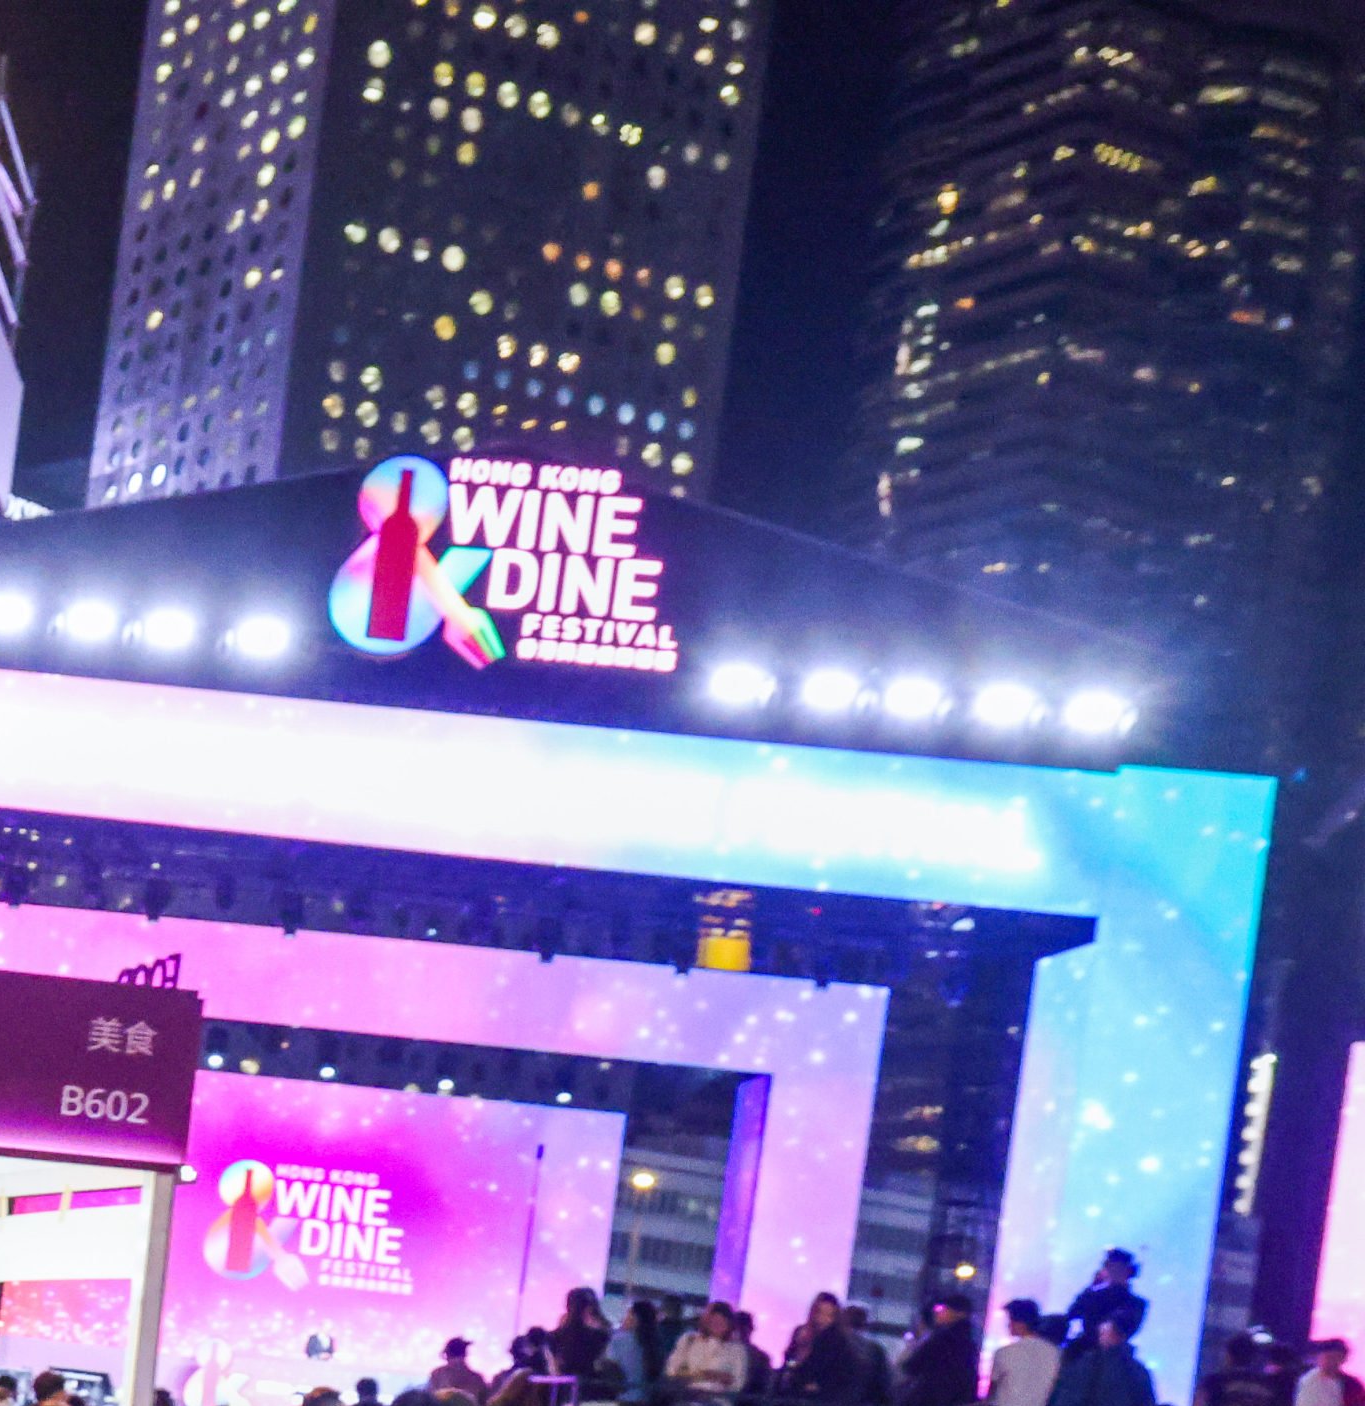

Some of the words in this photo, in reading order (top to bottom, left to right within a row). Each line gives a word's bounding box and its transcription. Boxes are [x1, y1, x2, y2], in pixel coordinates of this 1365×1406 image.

[449, 457, 532, 488] HONG
[537, 464, 623, 496] KONG
[448, 483, 644, 559] WINE
[485, 547, 665, 623] DINE
[520, 612, 679, 651] FESTIVAL
[87, 1016, 158, 1056] 美食
[60, 1084, 150, 1124] B602
[275, 1178, 393, 1228] WINE
[299, 1218, 415, 1266] DINE
[320, 1258, 423, 1284] FESTIVAL
